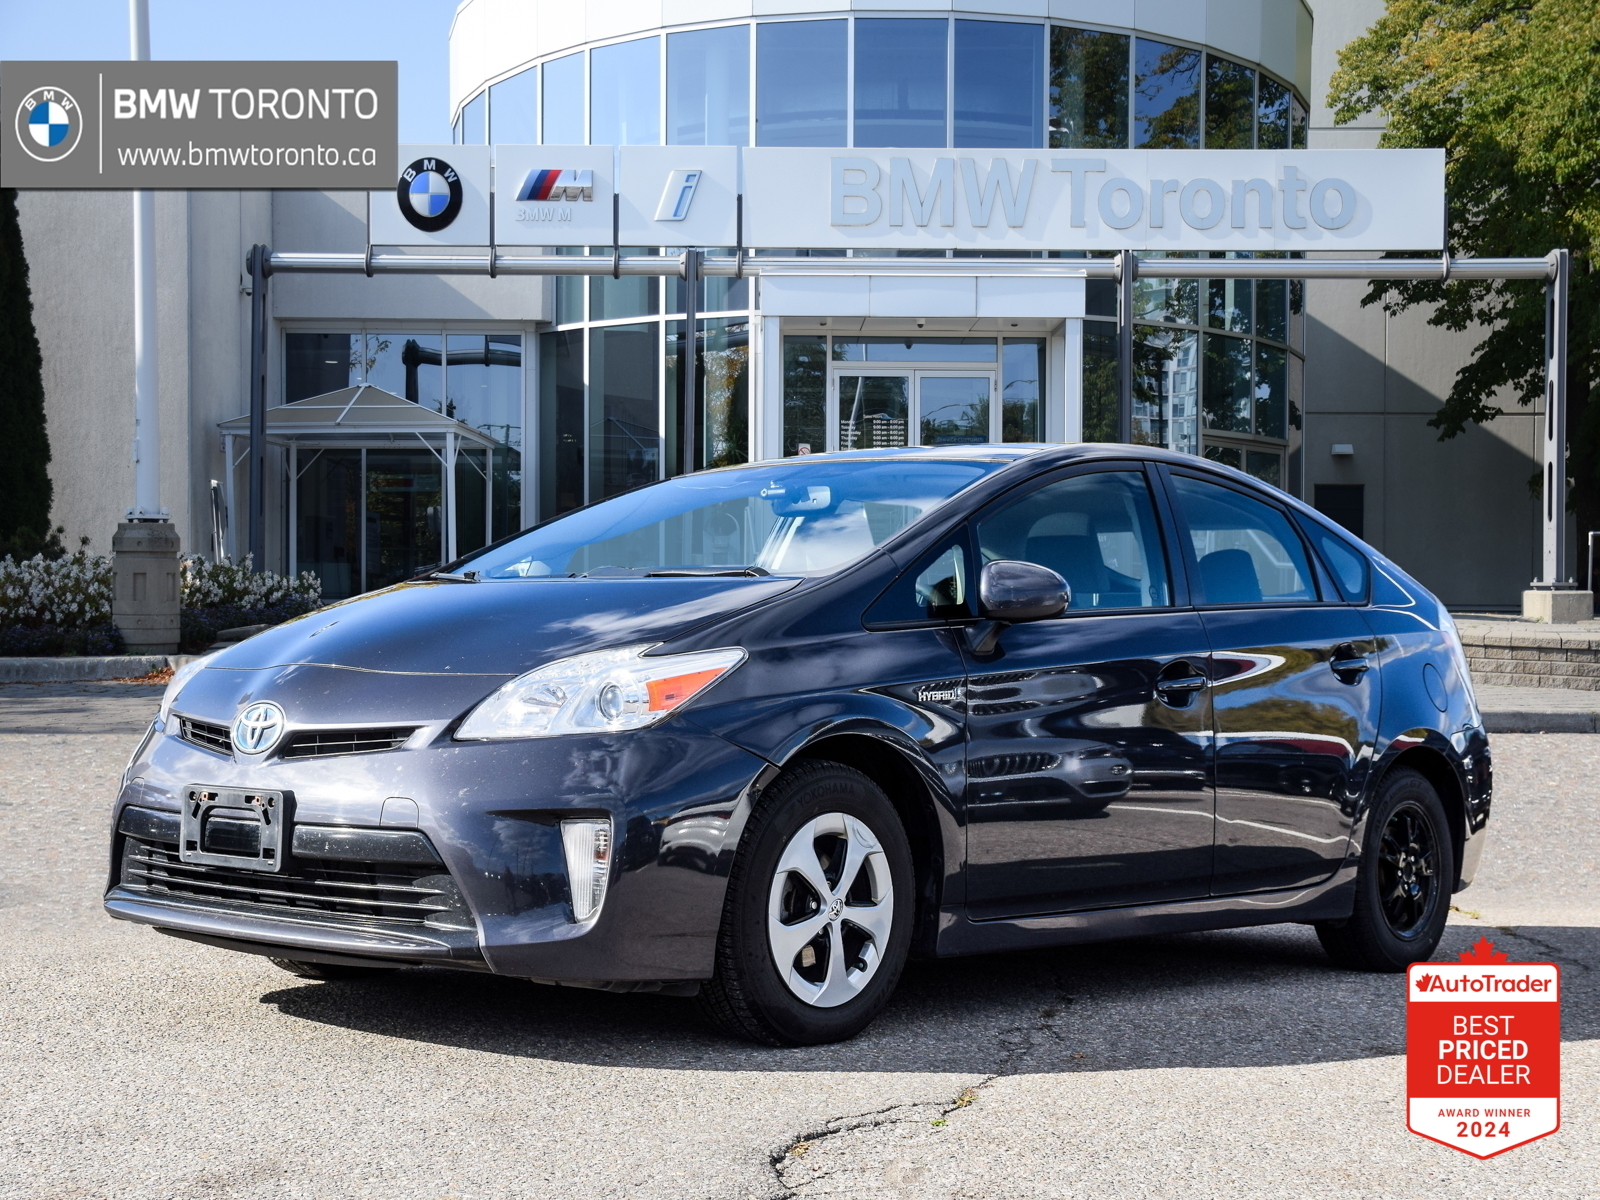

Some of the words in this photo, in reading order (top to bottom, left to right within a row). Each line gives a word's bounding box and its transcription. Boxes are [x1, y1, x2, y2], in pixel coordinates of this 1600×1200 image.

[402, 158, 458, 183] BMW
[830, 155, 1038, 229] BMW
[1051, 157, 1357, 231] Toronto
[514, 207, 555, 222] BMW
[558, 207, 572, 222] M
[918, 690, 955, 702] HYBRID
[796, 782, 855, 808] YOKOHAMA
